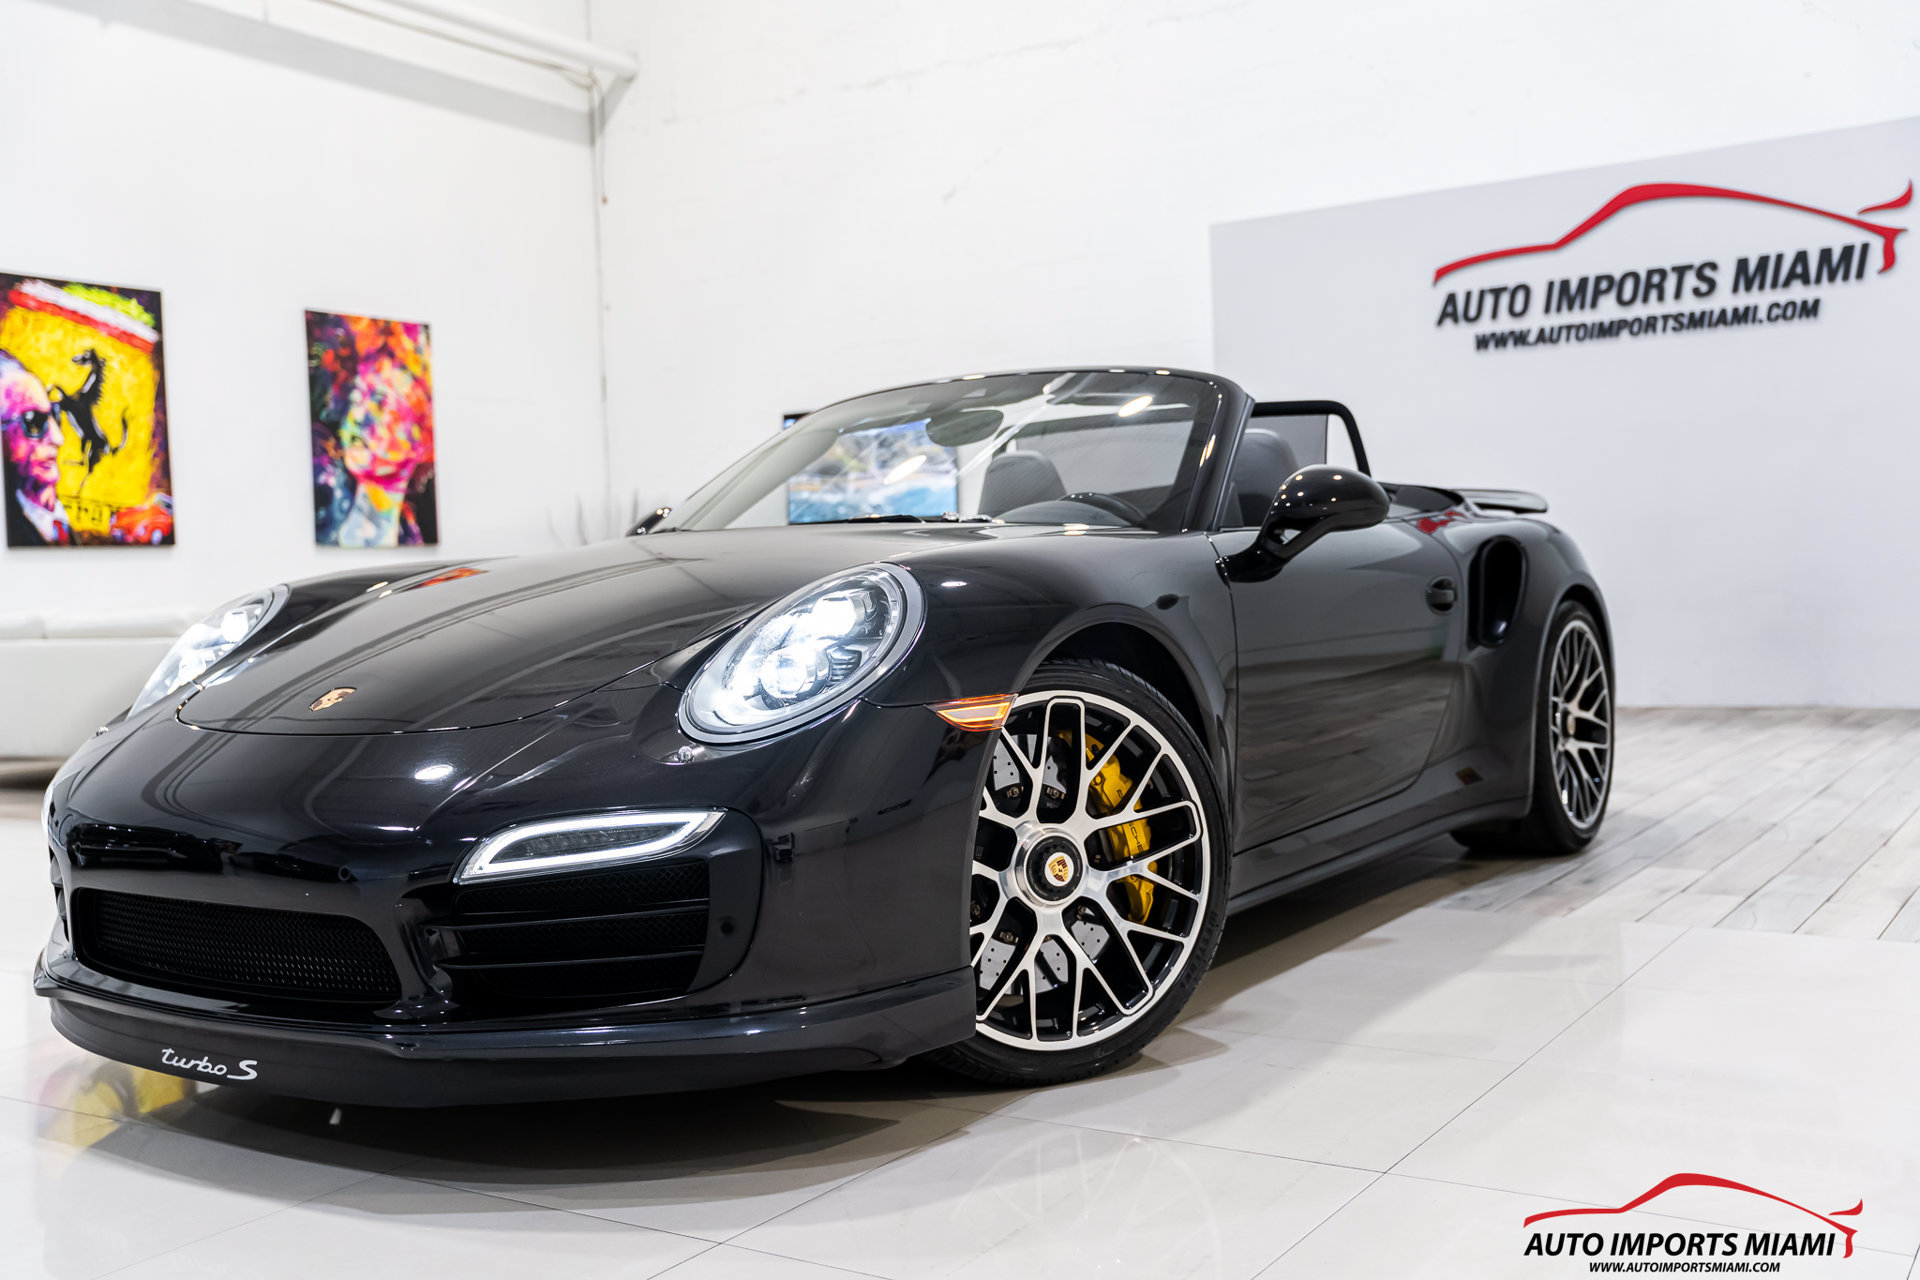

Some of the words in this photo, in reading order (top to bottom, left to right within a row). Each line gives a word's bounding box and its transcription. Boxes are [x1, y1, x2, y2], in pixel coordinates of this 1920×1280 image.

[1437, 284, 1531, 327] AUTO
[1544, 265, 1719, 315] IMPORTS
[1732, 242, 1870, 295] MIAMI
[1475, 298, 1821, 351] WWW.AUTOIMPORTSMIAMI.COM
[161, 1047, 228, 1076] turbo
[227, 1059, 258, 1081] S
